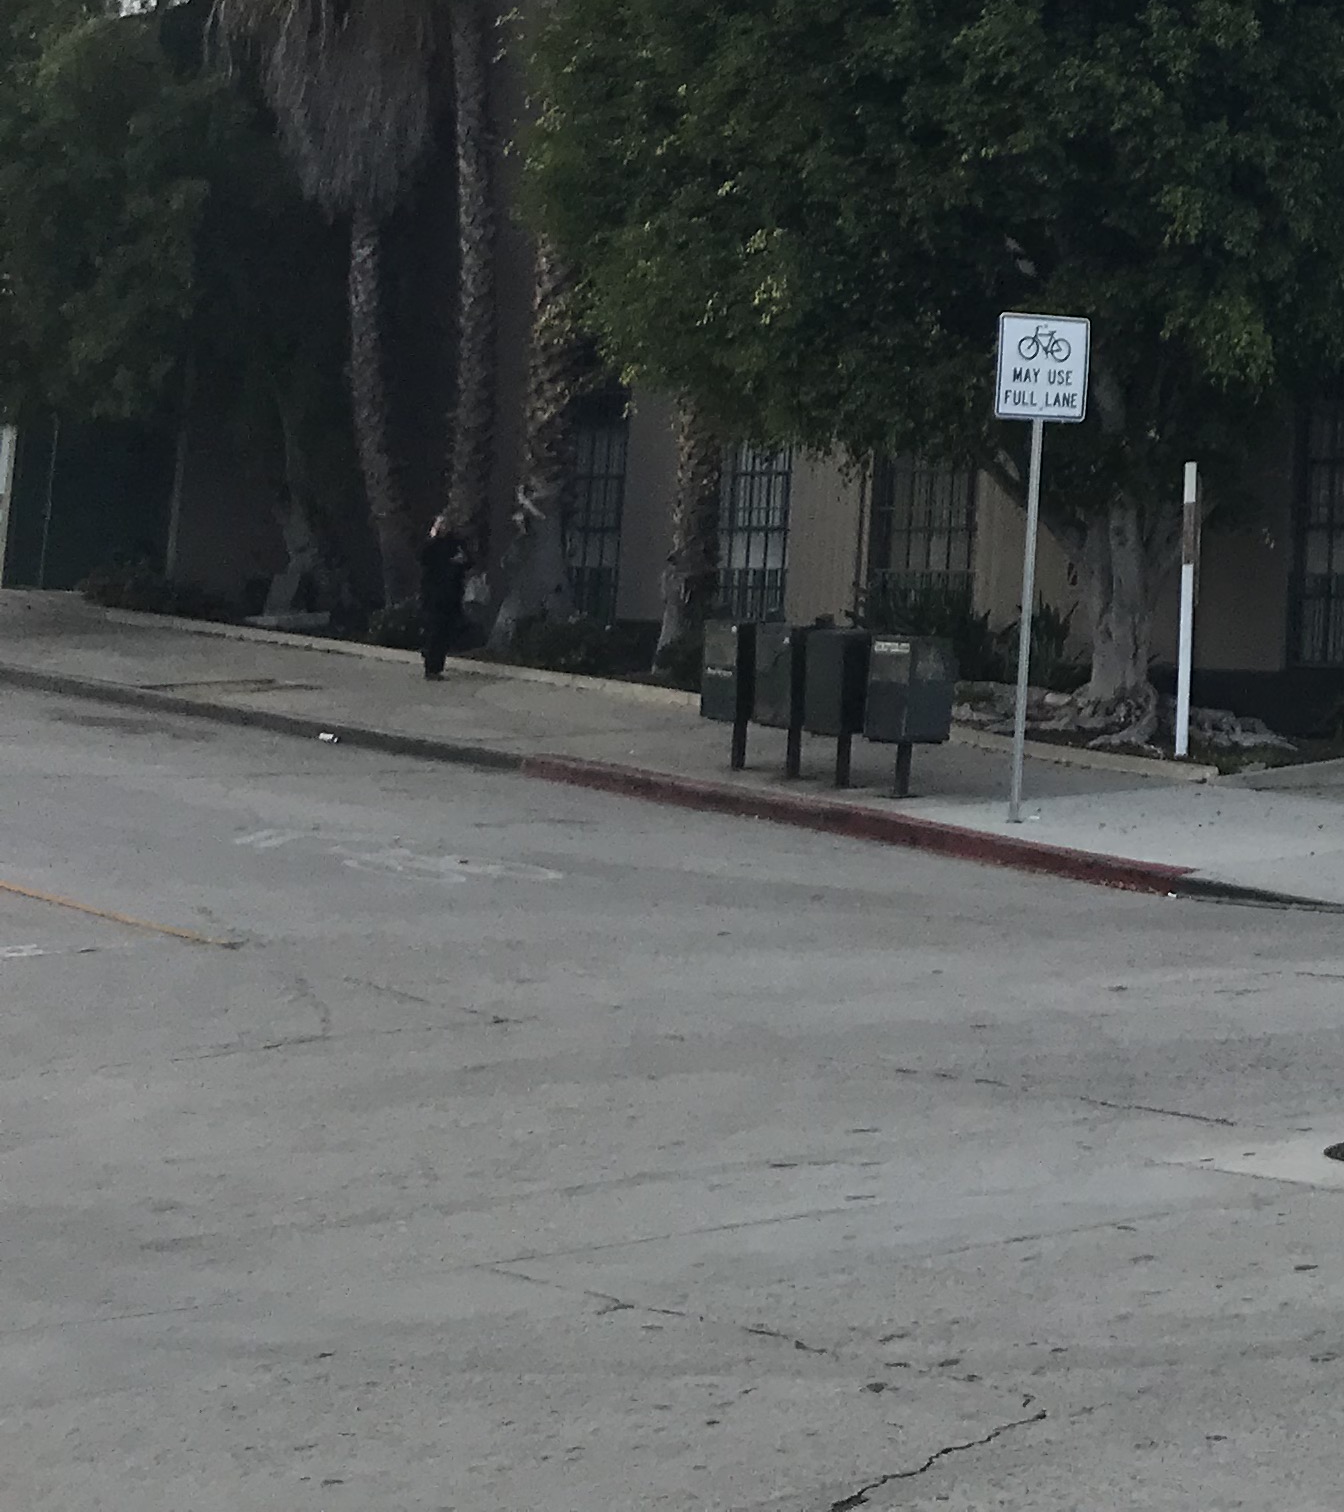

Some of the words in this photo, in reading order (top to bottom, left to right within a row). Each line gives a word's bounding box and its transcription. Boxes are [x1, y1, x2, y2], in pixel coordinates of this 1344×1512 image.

[1012, 367, 1040, 383] MAY
[1047, 369, 1073, 386] USE
[1004, 390, 1037, 407] FULL
[1045, 392, 1078, 408] LANE
